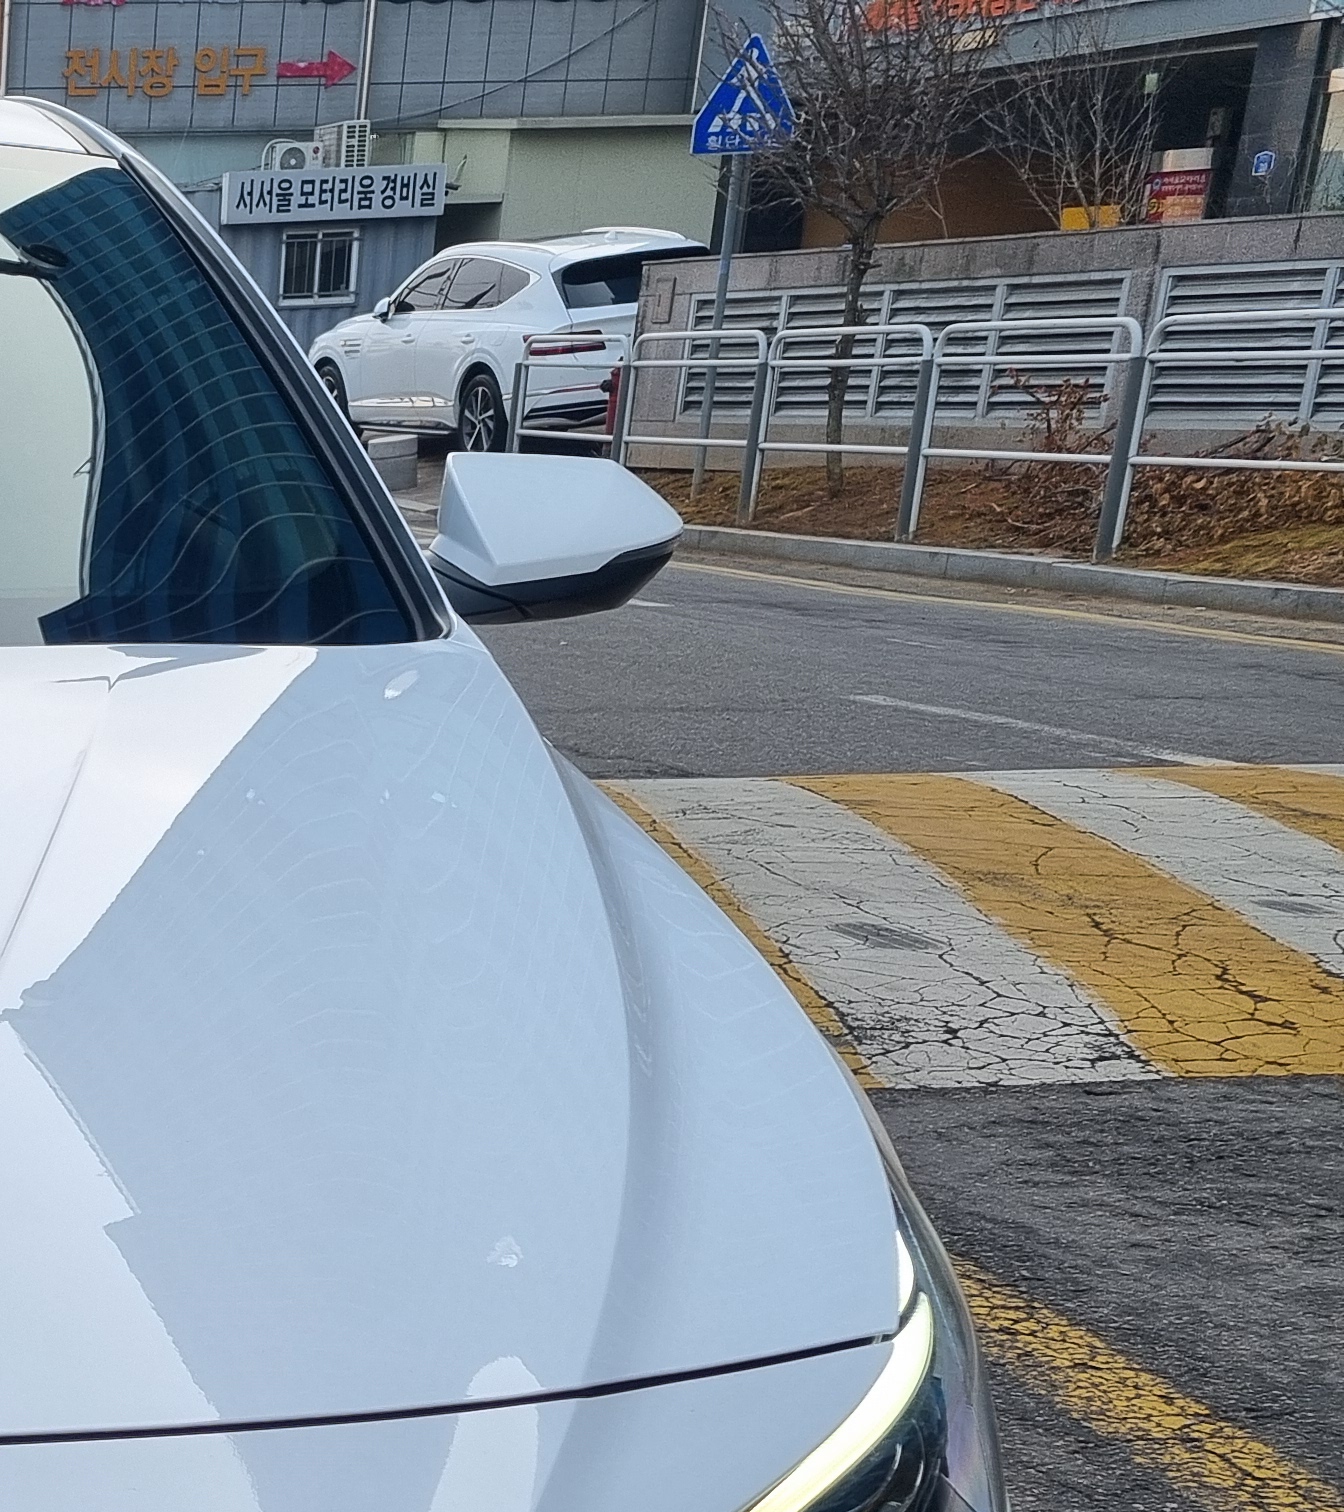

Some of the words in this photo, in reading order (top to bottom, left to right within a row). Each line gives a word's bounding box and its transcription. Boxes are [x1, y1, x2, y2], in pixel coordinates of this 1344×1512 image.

[64, 48, 180, 97] 전시장
[194, 47, 268, 96] 입구
[235, 177, 294, 215] 서서울
[297, 174, 376, 212] 모터리움
[380, 171, 438, 210] 경비실
